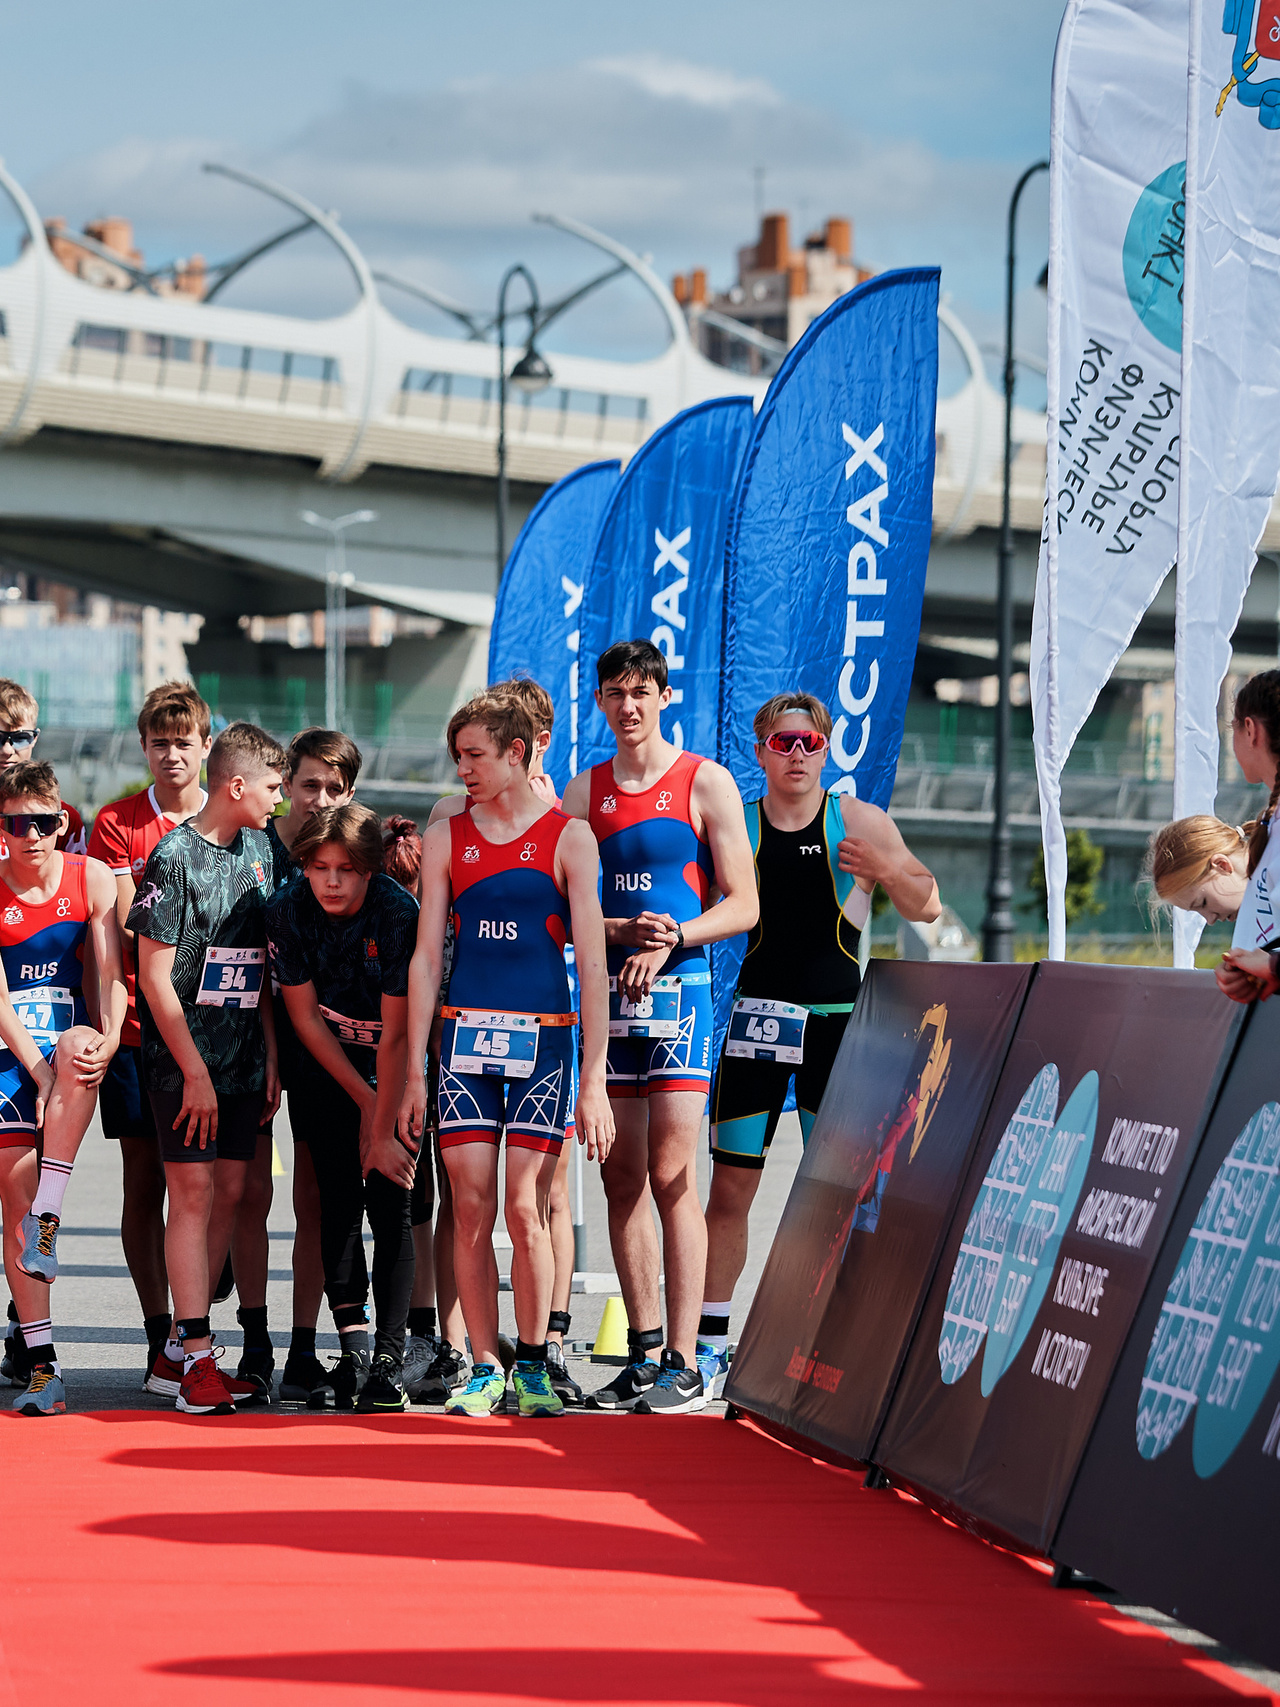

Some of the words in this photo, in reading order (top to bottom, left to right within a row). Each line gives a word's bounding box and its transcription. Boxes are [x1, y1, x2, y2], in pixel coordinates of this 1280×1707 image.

[800, 844, 822, 855] TYR
[615, 872, 652, 891] RUS
[478, 919, 518, 941] RUS
[19, 961, 59, 980] RUS
[218, 966, 248, 990] 34
[17, 1003, 52, 1029] 47
[338, 1024, 374, 1044] 33
[745, 1016, 780, 1043] 49
[472, 1030, 511, 1057] 45
[701, 1035, 711, 1067] TITAN
